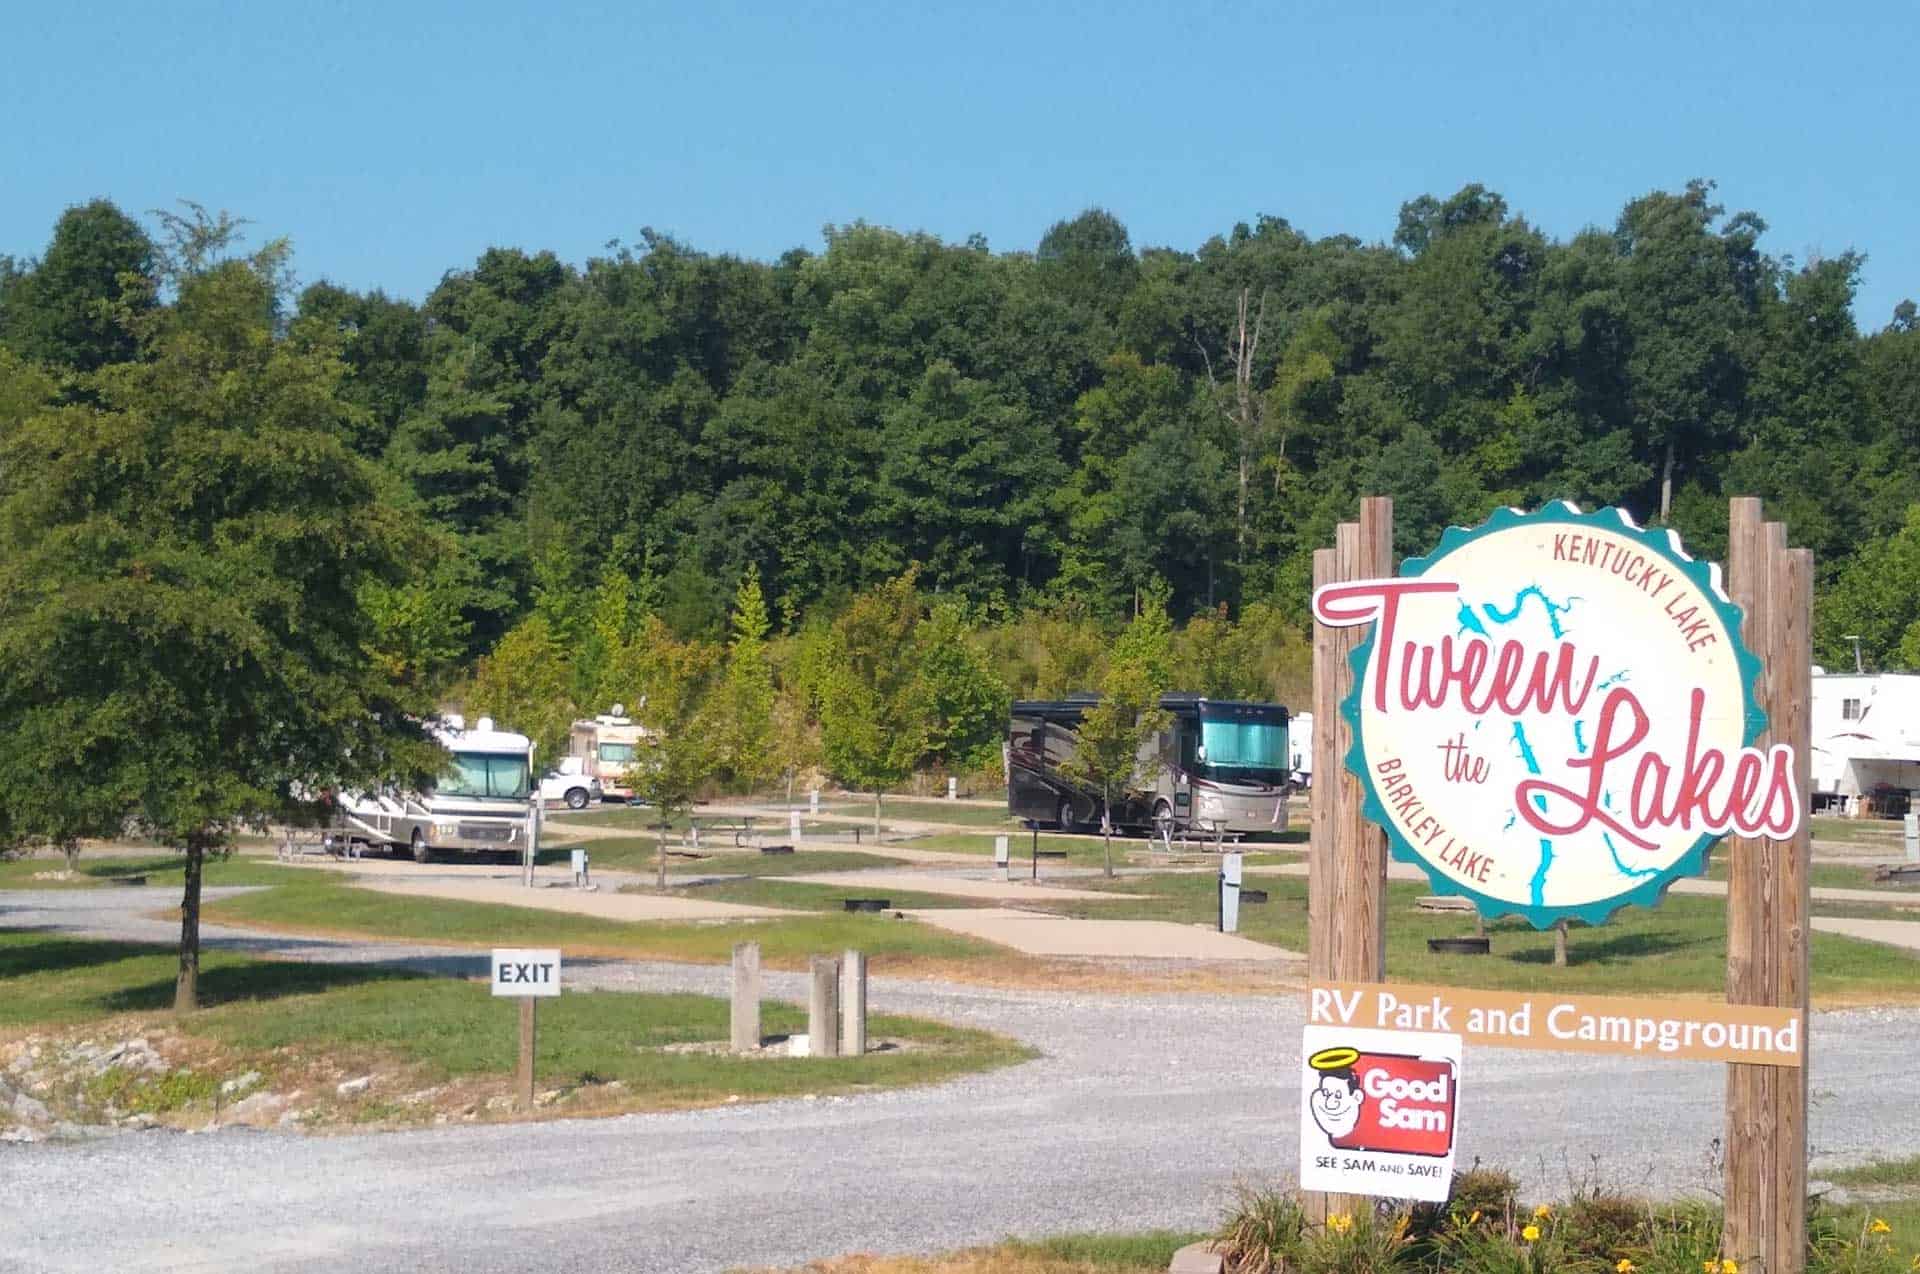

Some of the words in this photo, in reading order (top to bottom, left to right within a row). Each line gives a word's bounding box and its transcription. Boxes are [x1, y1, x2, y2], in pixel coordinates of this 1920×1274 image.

[1553, 533, 1673, 599] KENTUCKY
[1664, 588, 1718, 654] LAKE
[1317, 583, 1599, 715] Tween
[1437, 732, 1490, 785] the
[1516, 688, 1795, 850] Lakes
[1376, 758, 1441, 848] BARKLEY
[1439, 844, 1495, 884] LAKE
[499, 963, 553, 983] EXIT
[1310, 988, 1363, 1024] RV
[1377, 993, 1453, 1031] Park
[1466, 1001, 1532, 1037] and
[1546, 1004, 1798, 1053] Campground
[1363, 1068, 1448, 1104] Good
[1379, 1099, 1446, 1132] Sam
[1315, 1156, 1337, 1169] SEE
[1342, 1158, 1376, 1173] SAM
[1379, 1165, 1404, 1175] AND
[1407, 1163, 1442, 1178] SAVE!
